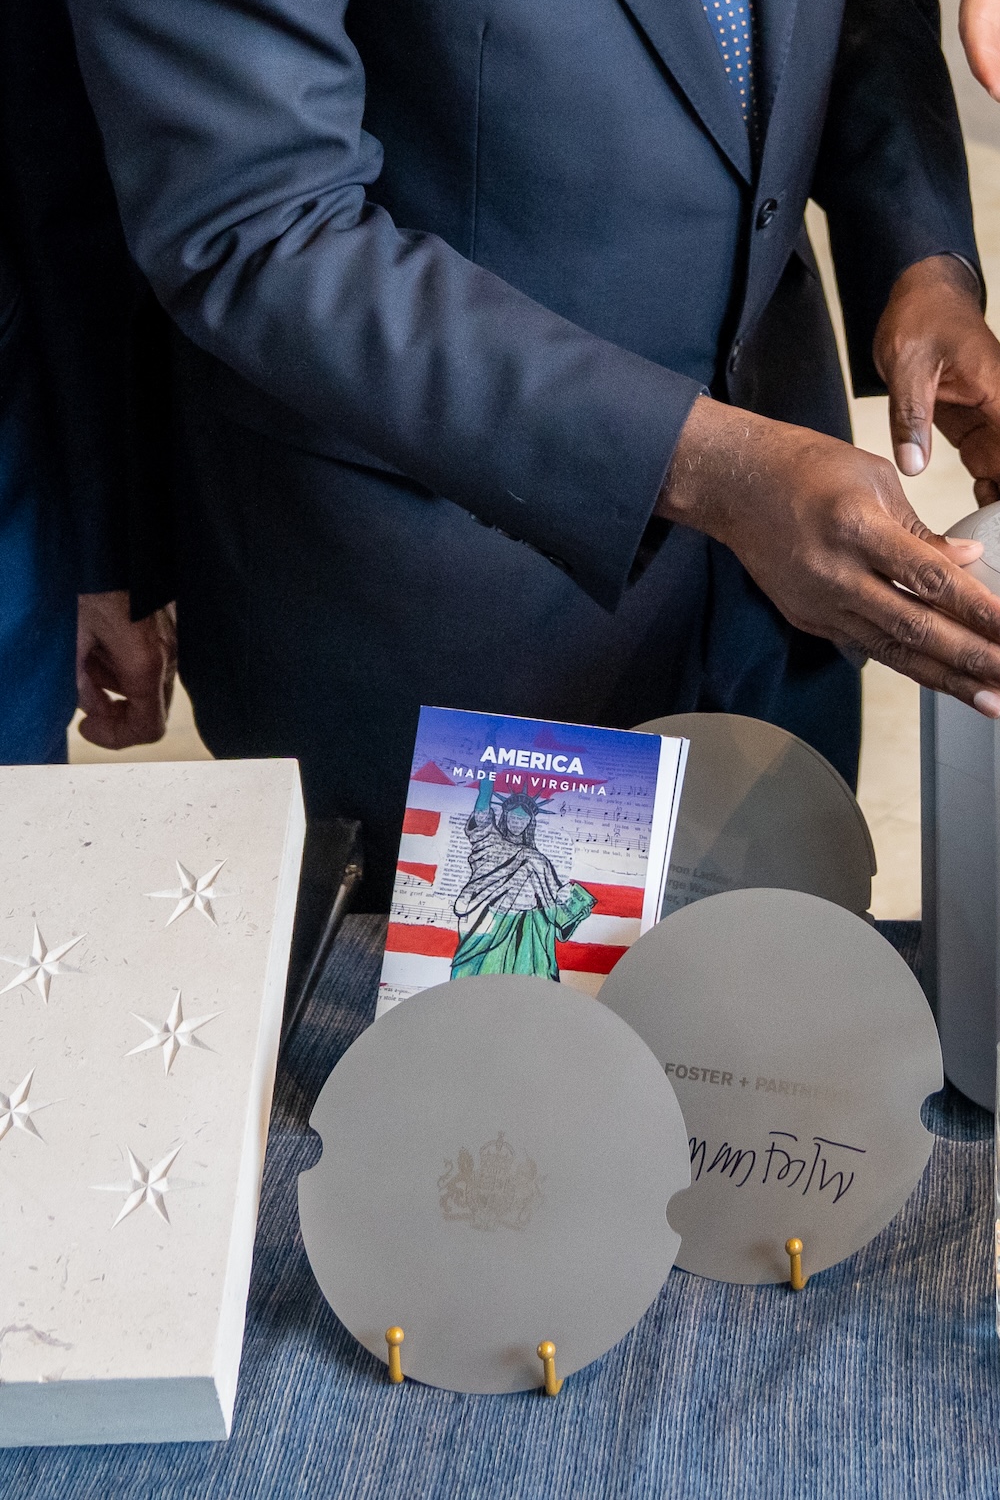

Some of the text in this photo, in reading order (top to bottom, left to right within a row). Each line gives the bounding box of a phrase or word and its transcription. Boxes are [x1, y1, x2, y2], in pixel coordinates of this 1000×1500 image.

[480, 746, 584, 775] AMERICA
[453, 767, 606, 796] MADE IN VIRGINIA
[664, 1062, 850, 1102] FOSTER + PARTNE
